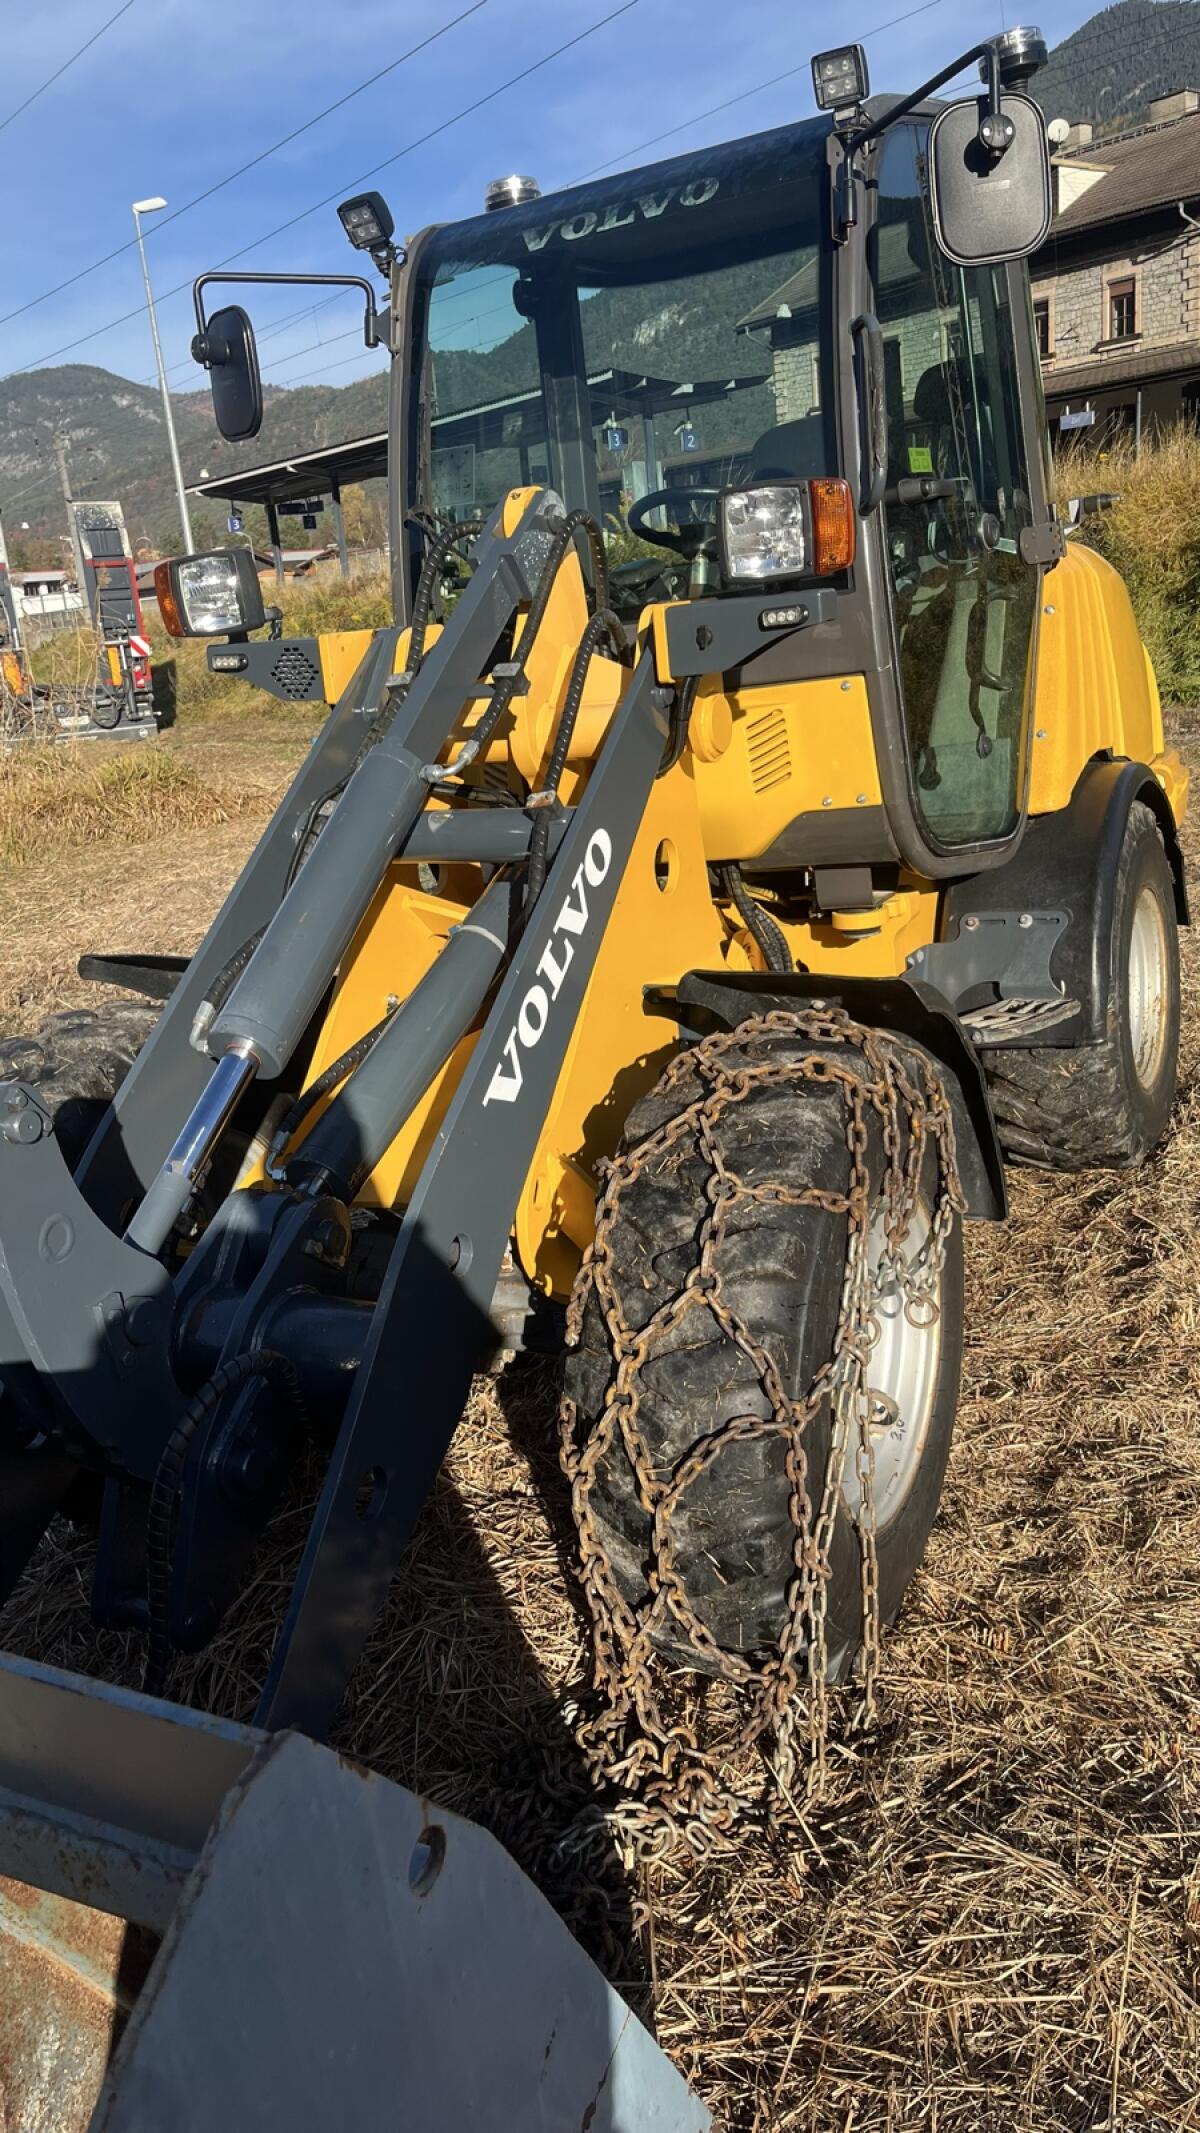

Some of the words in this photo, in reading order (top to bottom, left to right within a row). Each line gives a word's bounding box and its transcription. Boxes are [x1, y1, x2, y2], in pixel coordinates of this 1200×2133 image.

[521, 176, 720, 252] VOLVO
[613, 433, 621, 447] 3
[687, 435, 696, 448] 2
[233, 519, 240, 530] 3
[482, 828, 613, 1107] VOLVO
